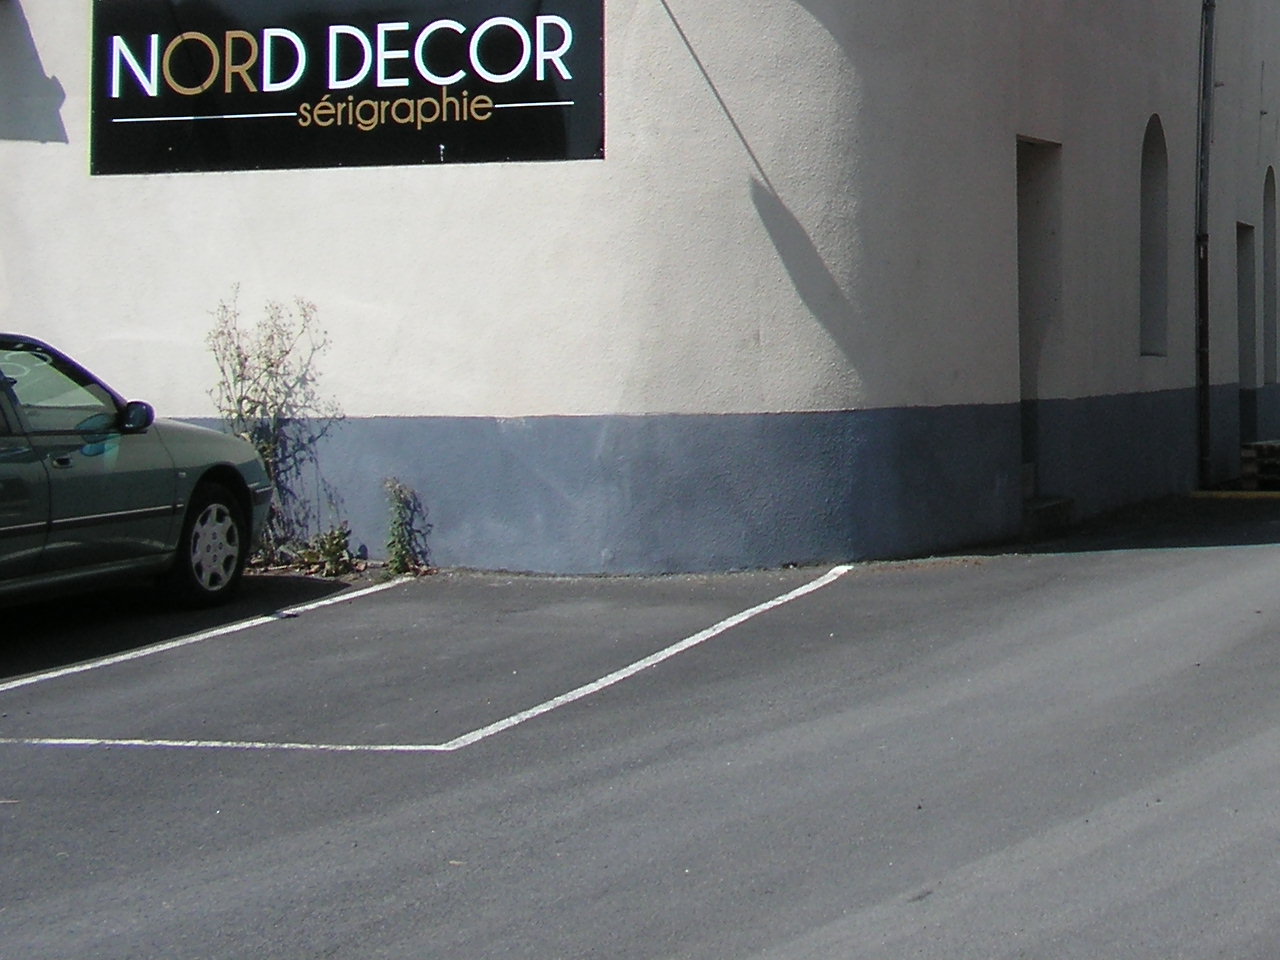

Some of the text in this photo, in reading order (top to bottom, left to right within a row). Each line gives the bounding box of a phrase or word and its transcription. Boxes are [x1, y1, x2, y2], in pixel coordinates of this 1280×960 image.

[111, 15, 573, 98] NORD DECOR
[298, 86, 493, 130] sérigraphie
